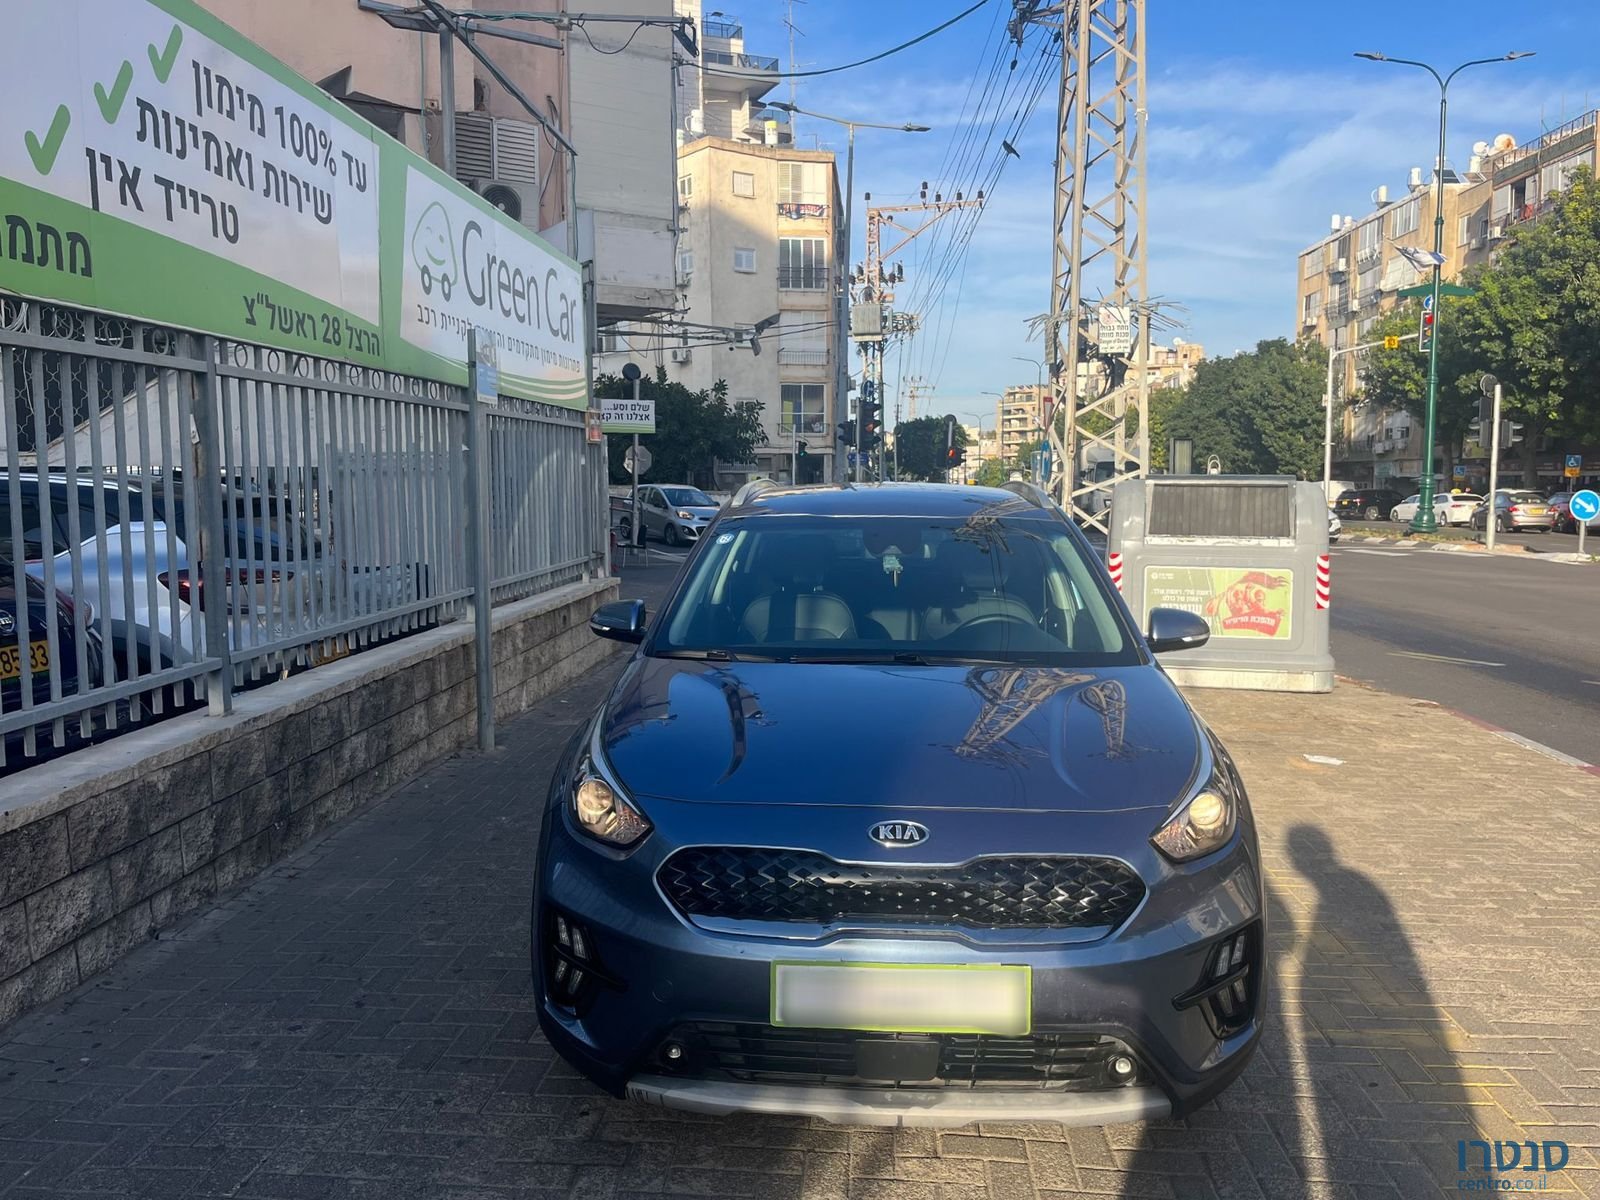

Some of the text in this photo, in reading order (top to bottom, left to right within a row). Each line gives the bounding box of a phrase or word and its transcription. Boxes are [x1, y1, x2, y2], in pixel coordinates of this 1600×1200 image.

[192, 59, 367, 193] עד 100% מימון
[136, 96, 333, 225] שירות ואמינות
[85, 147, 240, 245] טרייד אין
[0, 214, 93, 278] מתמ
[462, 219, 577, 344] Green Car
[320, 314, 342, 347] 28
[417, 304, 438, 328] רכב
[344, 318, 380, 357] הרצל
[507, 335, 540, 361] מתקדמים
[601, 411, 650, 422] אצלנו זה קצ
[604, 402, 650, 411] שלם וסע...
[879, 824, 920, 840] KIA
